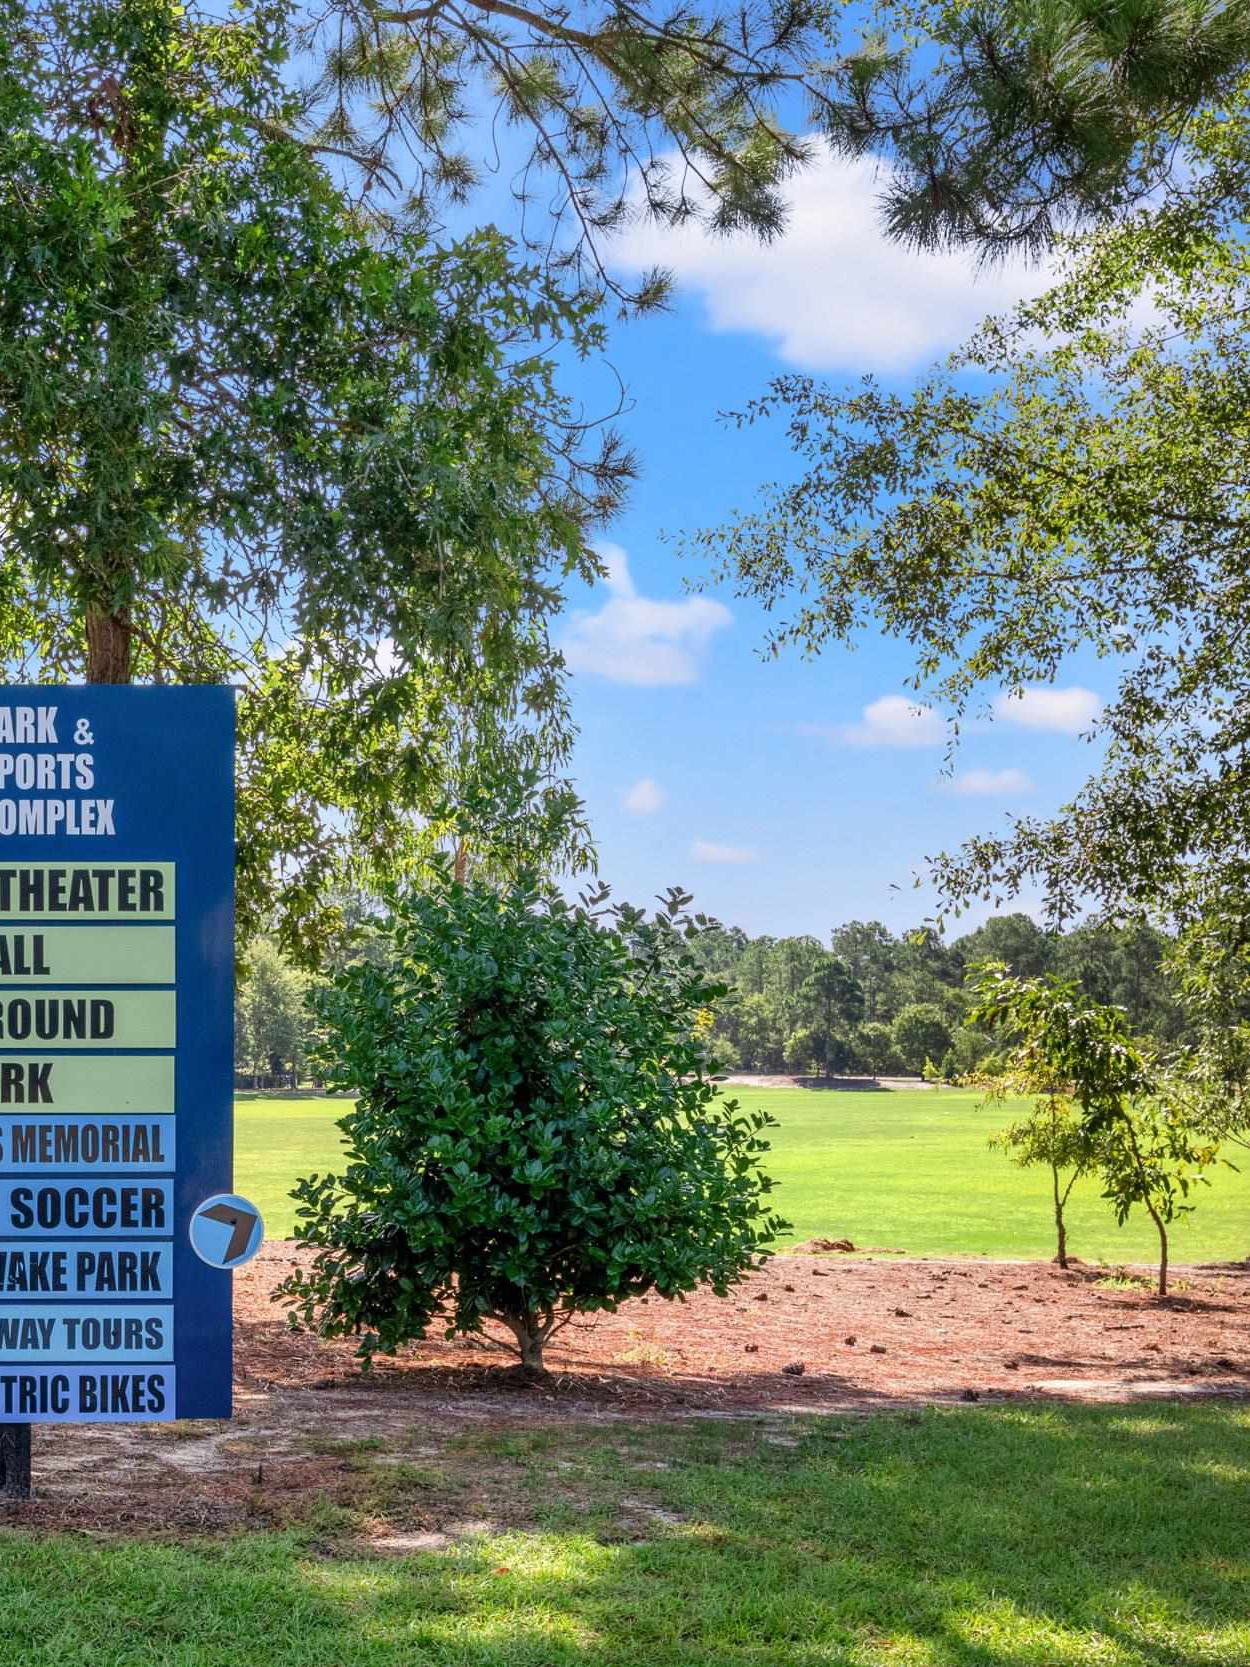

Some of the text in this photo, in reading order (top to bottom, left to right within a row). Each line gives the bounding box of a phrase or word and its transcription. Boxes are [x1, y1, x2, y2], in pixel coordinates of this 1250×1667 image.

[73, 719, 94, 745] &
[12, 1125, 164, 1163] MEMORIAL
[10, 1188, 165, 1229] SOCCER
[76, 1251, 161, 1293] PARK
[63, 1317, 164, 1351] TOURS
[81, 1375, 165, 1415] BIKES
